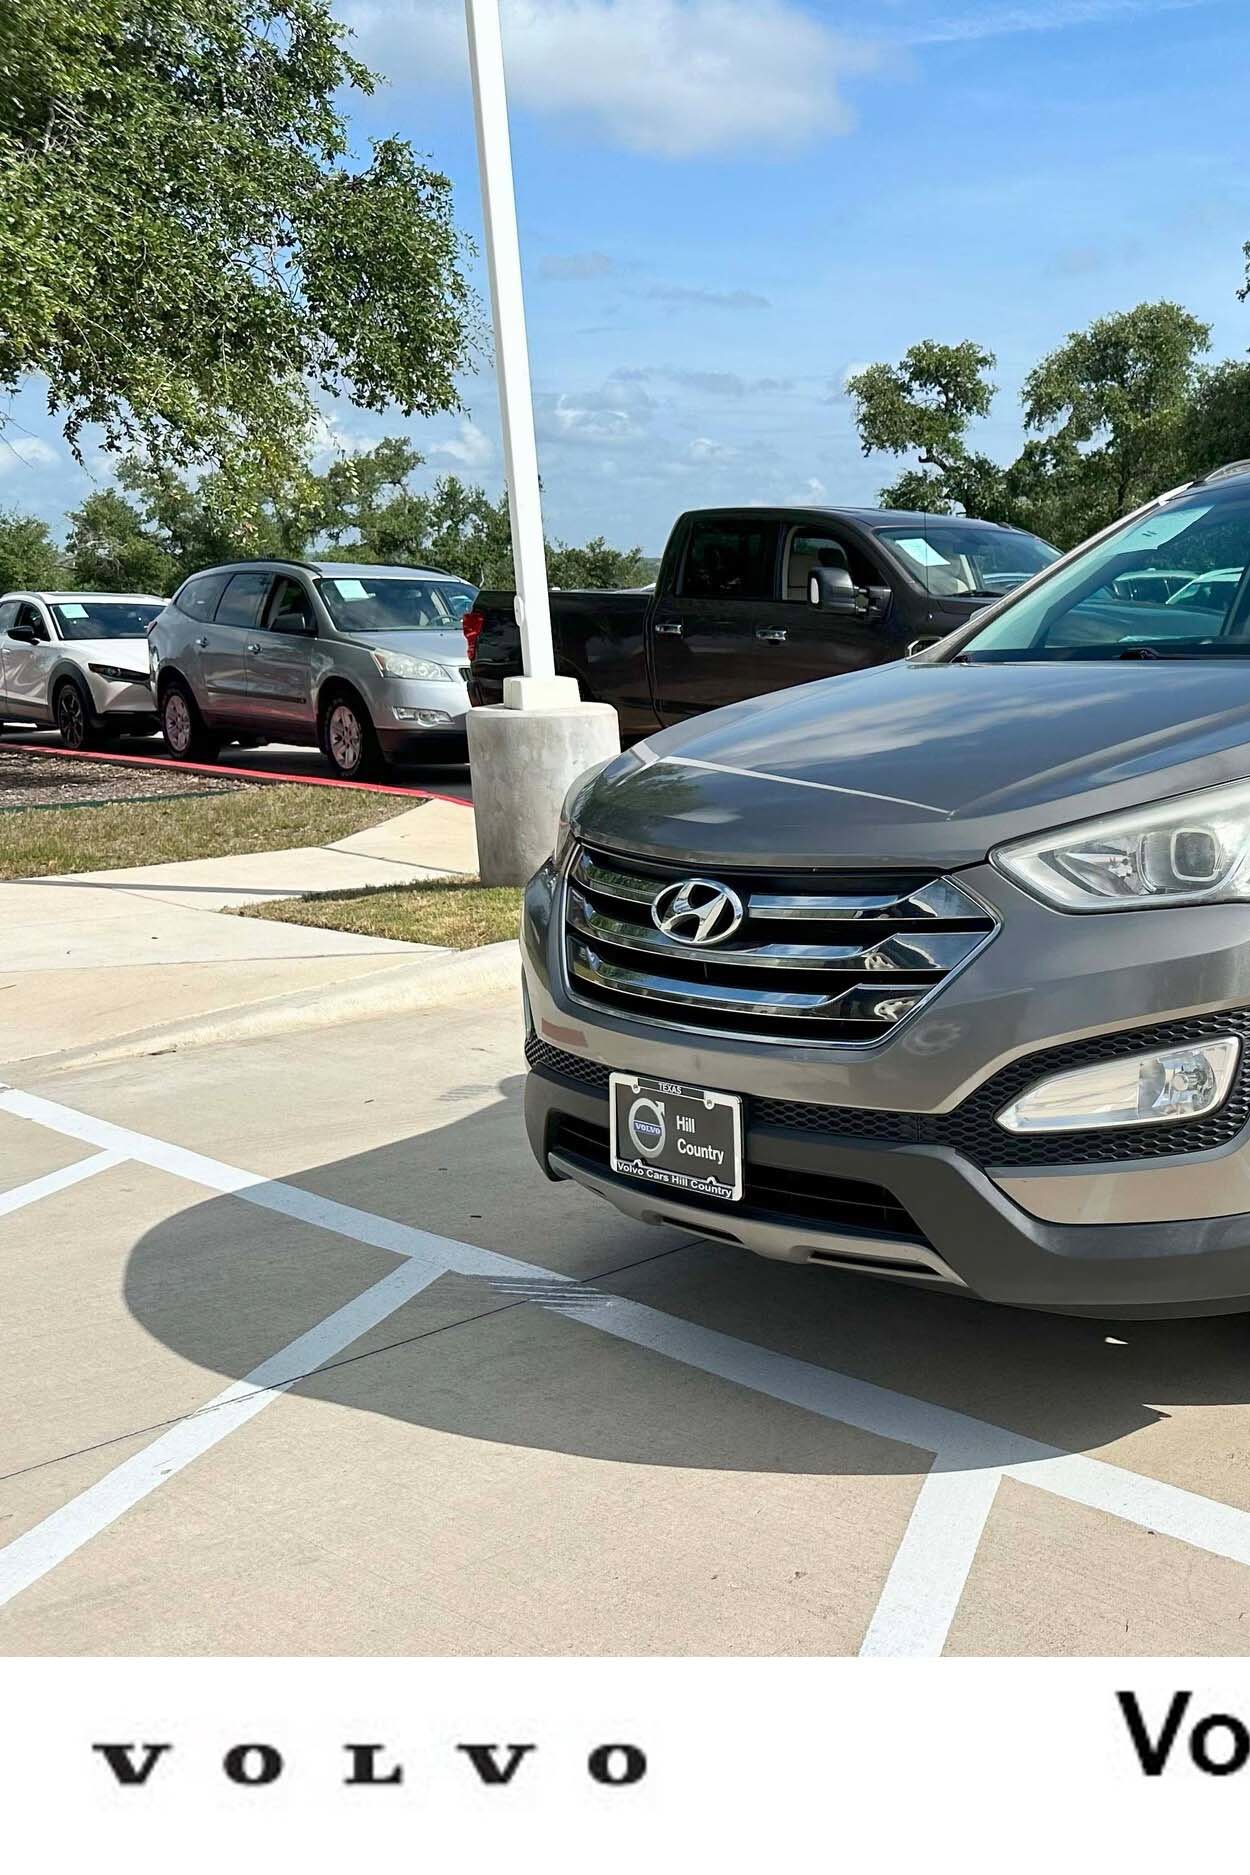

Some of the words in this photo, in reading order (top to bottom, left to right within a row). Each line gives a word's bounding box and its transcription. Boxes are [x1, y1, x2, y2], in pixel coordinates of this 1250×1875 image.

[658, 1082, 682, 1095] TEXAS
[634, 1122, 661, 1135] VOLVO
[676, 1115, 696, 1134] Hill
[677, 1138, 725, 1165] Country
[617, 1161, 645, 1176] Volvo
[646, 1169, 669, 1182] Cars
[671, 1175, 688, 1187] Hill
[690, 1180, 732, 1198] Country
